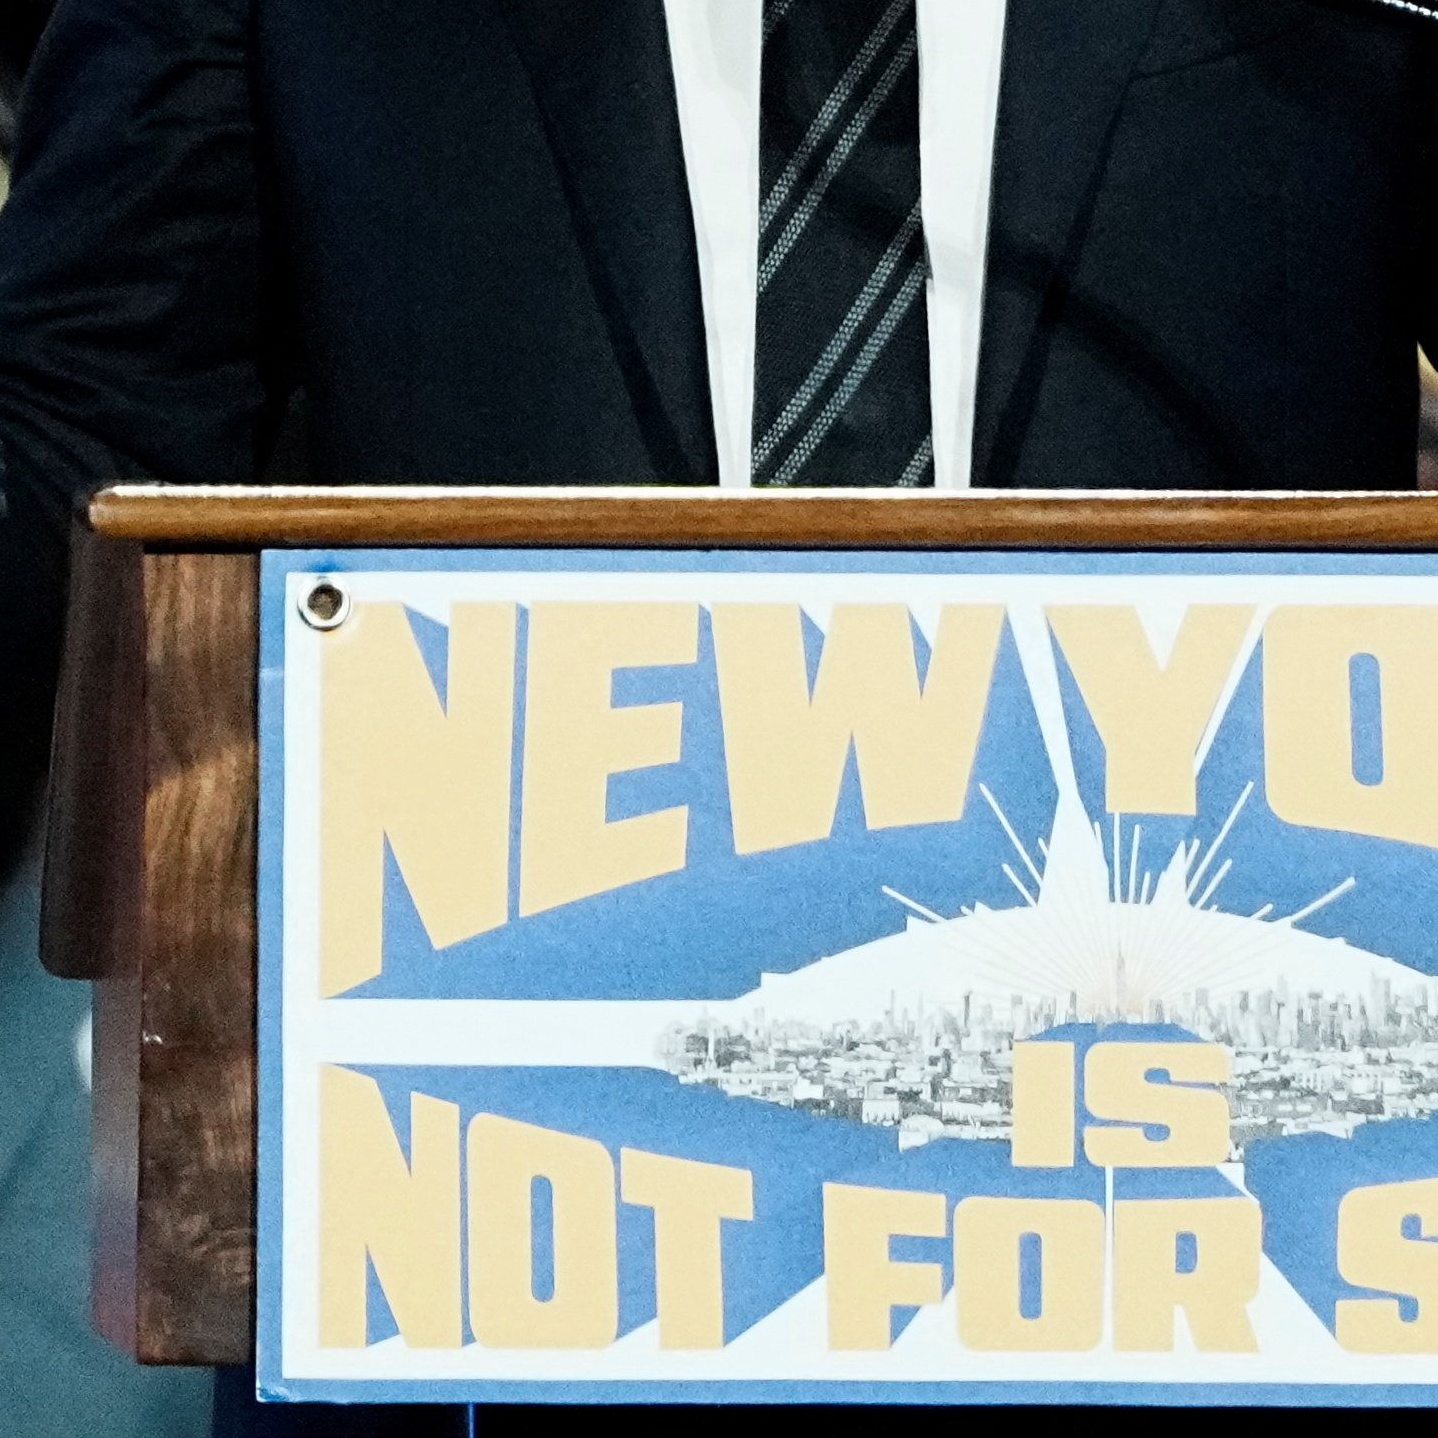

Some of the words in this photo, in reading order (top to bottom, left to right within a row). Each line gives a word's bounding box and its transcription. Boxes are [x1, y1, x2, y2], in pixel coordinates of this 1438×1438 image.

[320, 602, 1000, 996] NEW
[319, 1065, 753, 1350] NOT
[824, 1182, 1263, 1354] FOR
[1012, 1042, 1230, 1168] IS
